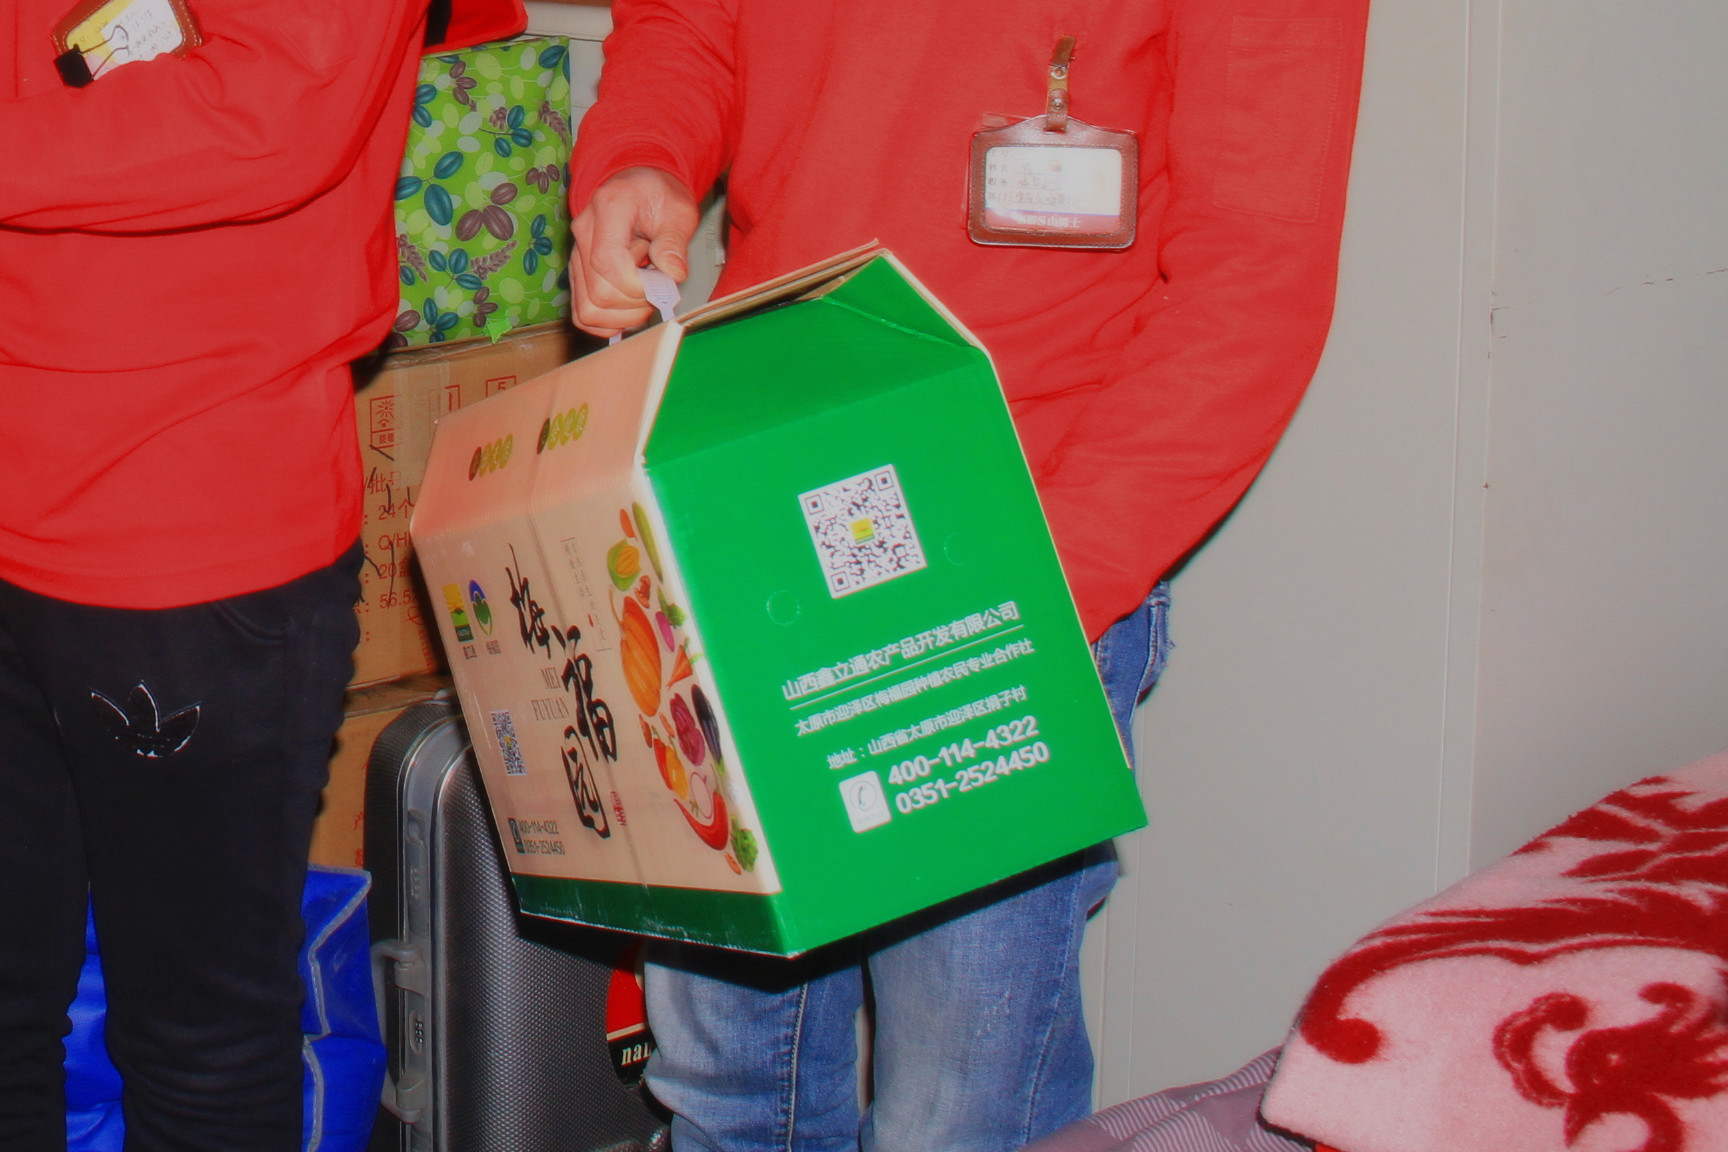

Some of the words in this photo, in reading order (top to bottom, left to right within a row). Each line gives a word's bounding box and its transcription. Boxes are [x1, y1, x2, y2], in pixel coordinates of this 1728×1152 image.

[782, 601, 1020, 701] 山西鑫立通农产品开发有限公司
[888, 715, 1040, 785] 400-114-4322
[895, 741, 1050, 814] 0351-2524450
